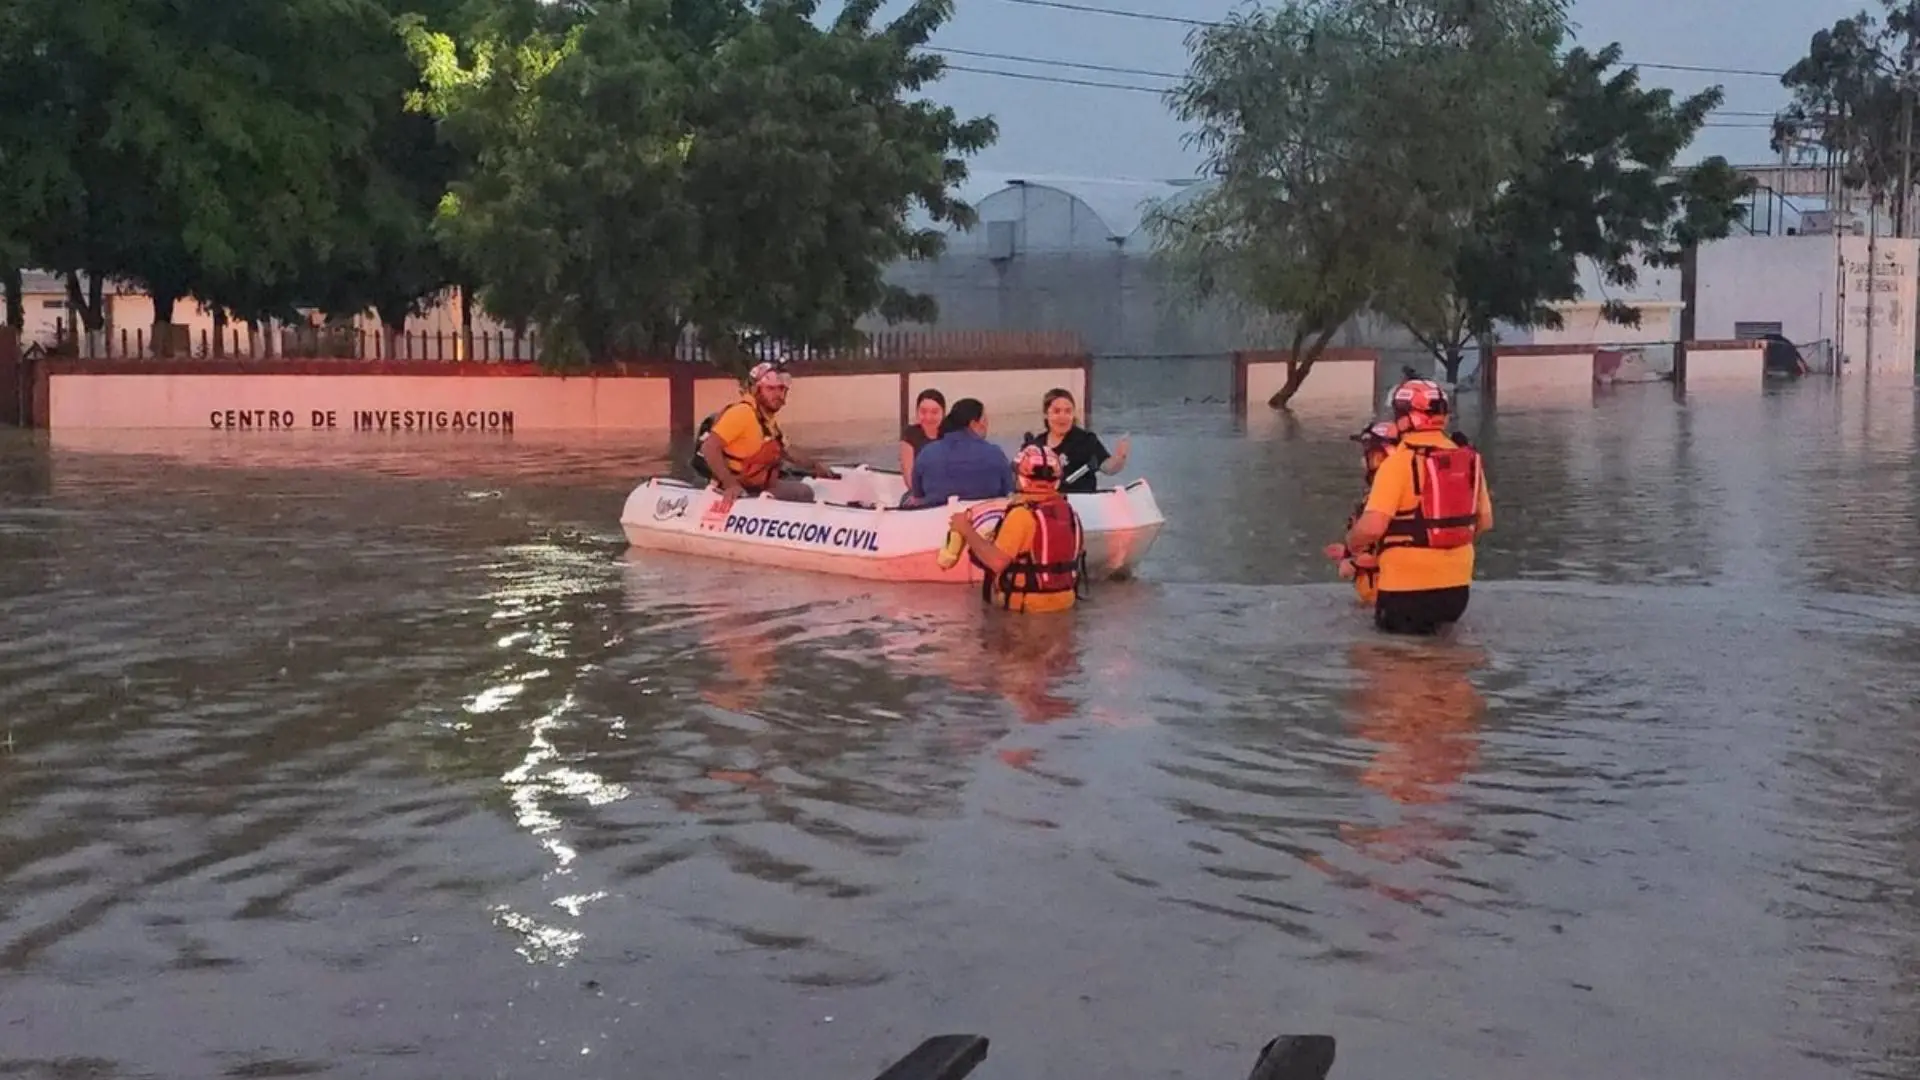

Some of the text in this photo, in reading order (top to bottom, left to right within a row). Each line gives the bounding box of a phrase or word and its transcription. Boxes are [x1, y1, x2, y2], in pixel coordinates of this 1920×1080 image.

[210, 410, 514, 431] CENTRO DE INVESTIGACION
[724, 514, 879, 551] PROTECCION CIVIL
